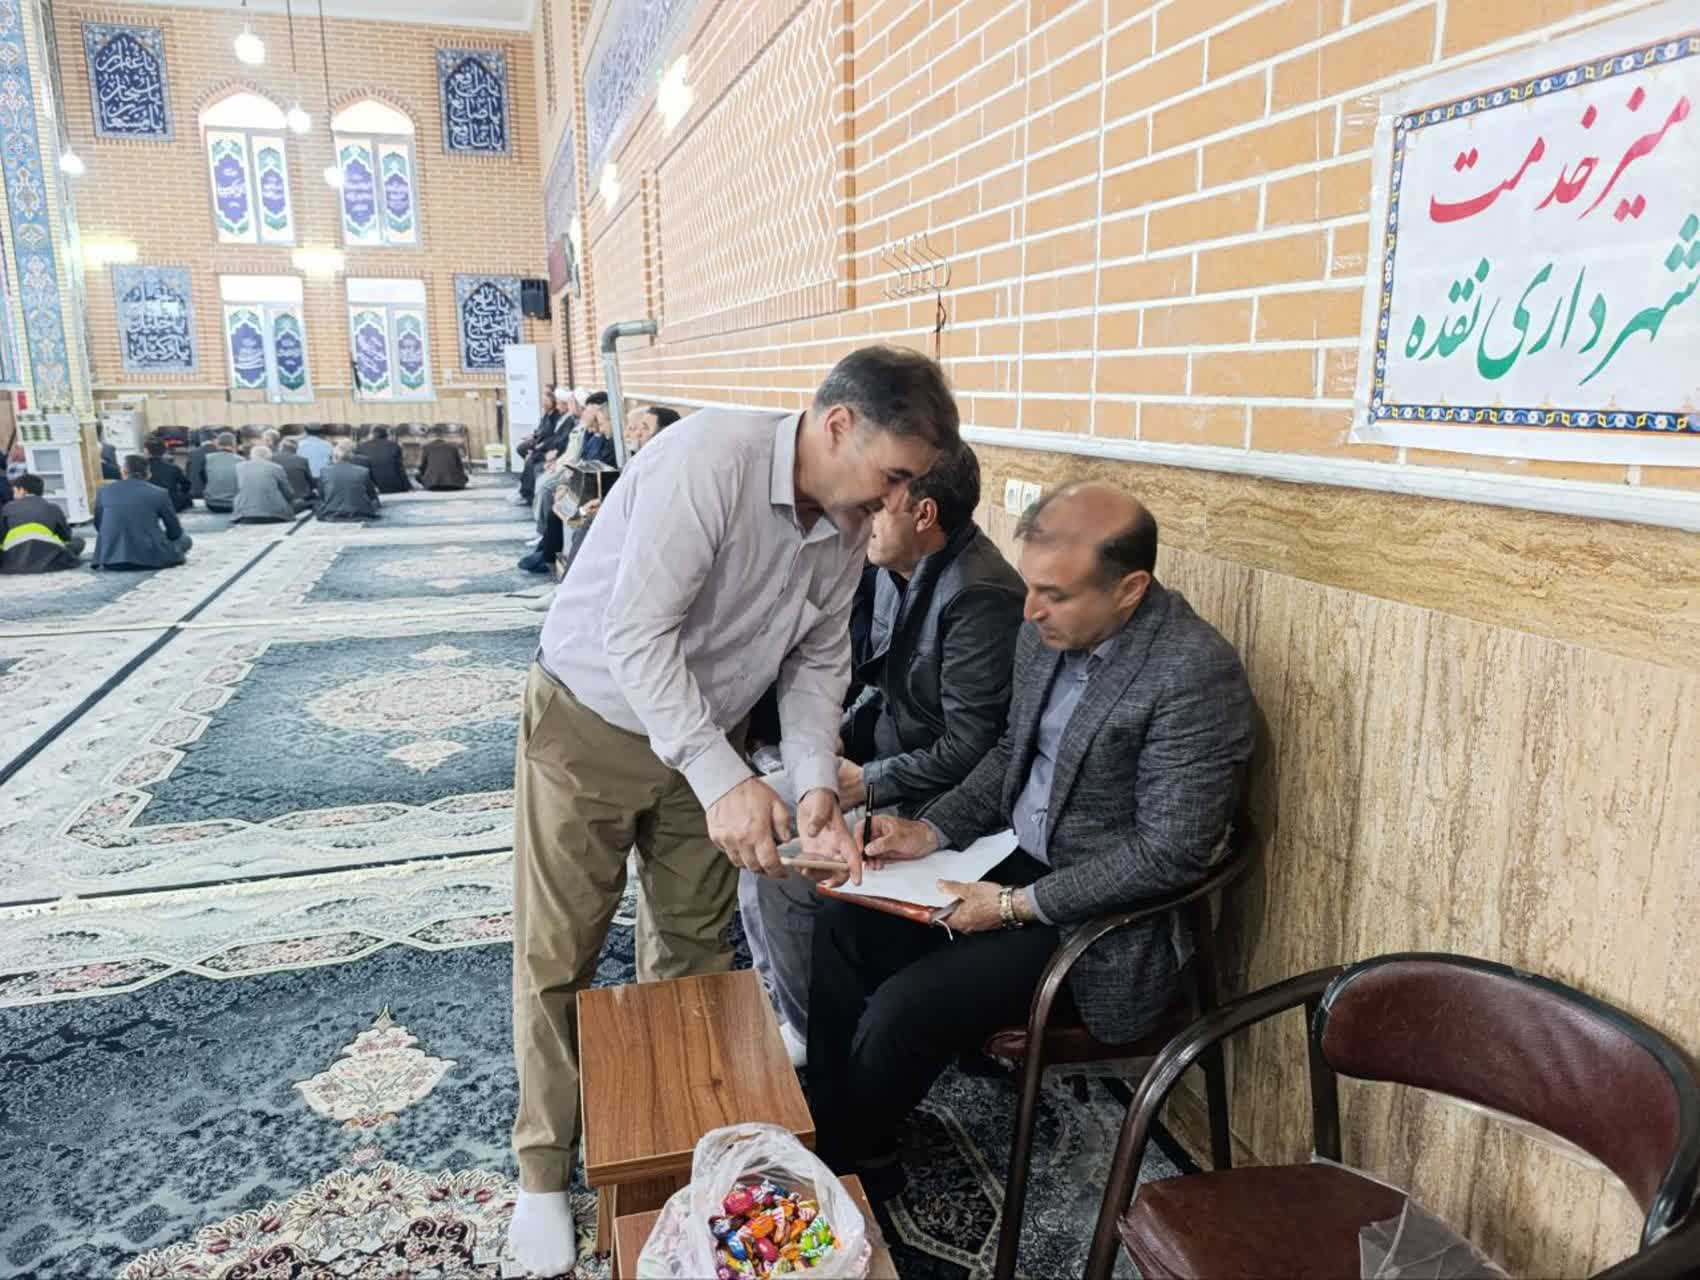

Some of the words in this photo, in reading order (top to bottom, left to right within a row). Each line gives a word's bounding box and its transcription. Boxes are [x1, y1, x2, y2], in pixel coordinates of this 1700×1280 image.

[1429, 105, 1599, 224] خدمت
[1578, 87, 1691, 222] میز
[1405, 257, 1490, 360] نقده
[1476, 213, 1700, 385] شهرداری
